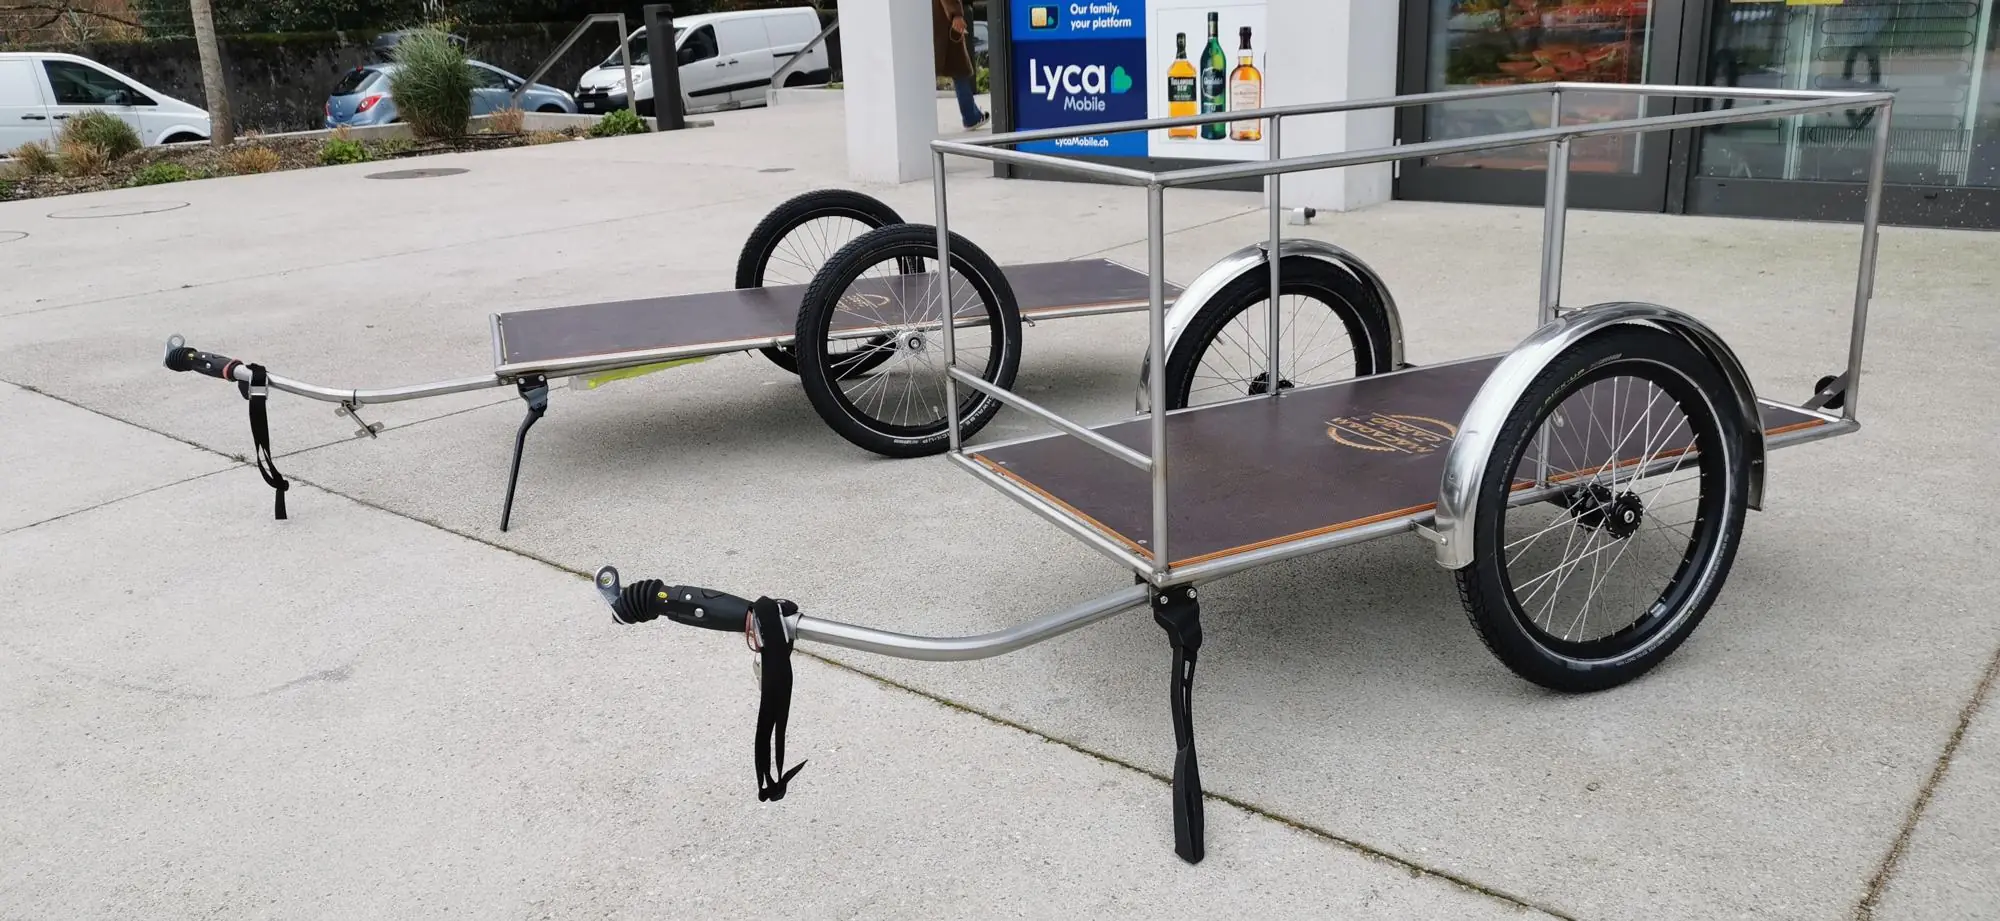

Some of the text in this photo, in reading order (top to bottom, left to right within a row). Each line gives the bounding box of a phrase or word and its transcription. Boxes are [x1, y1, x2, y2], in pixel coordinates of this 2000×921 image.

[1070, 2, 1119, 16] Our family,
[1071, 16, 1132, 31] your platform
[1030, 58, 1106, 100] Lyca
[1064, 95, 1106, 112] Mobile
[1055, 136, 1109, 148] LycaMobile.ch
